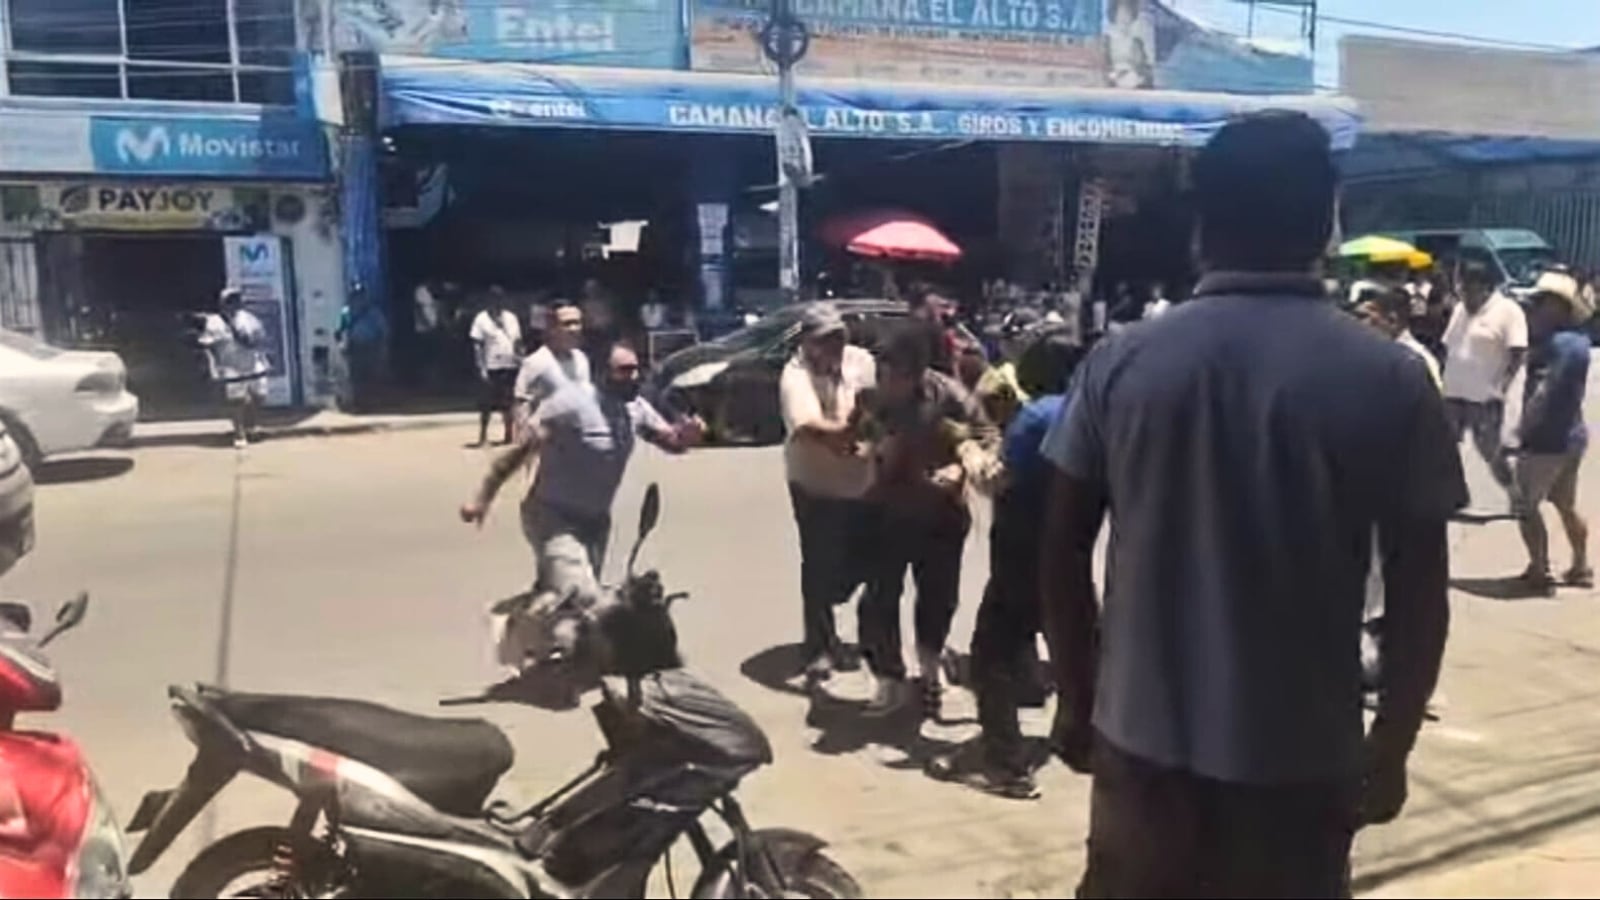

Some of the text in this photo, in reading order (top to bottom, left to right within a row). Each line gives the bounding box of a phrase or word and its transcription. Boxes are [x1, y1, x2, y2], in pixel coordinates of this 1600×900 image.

[930, 0, 964, 24] EL
[973, 0, 1037, 28] ALTO
[494, 8, 615, 52] Entel
[823, 108, 884, 132] ALTO
[958, 112, 1022, 136] GIROS
[1027, 117, 1040, 136] Y
[180, 130, 300, 157] Movistar
[98, 190, 213, 212] PAYJOY
